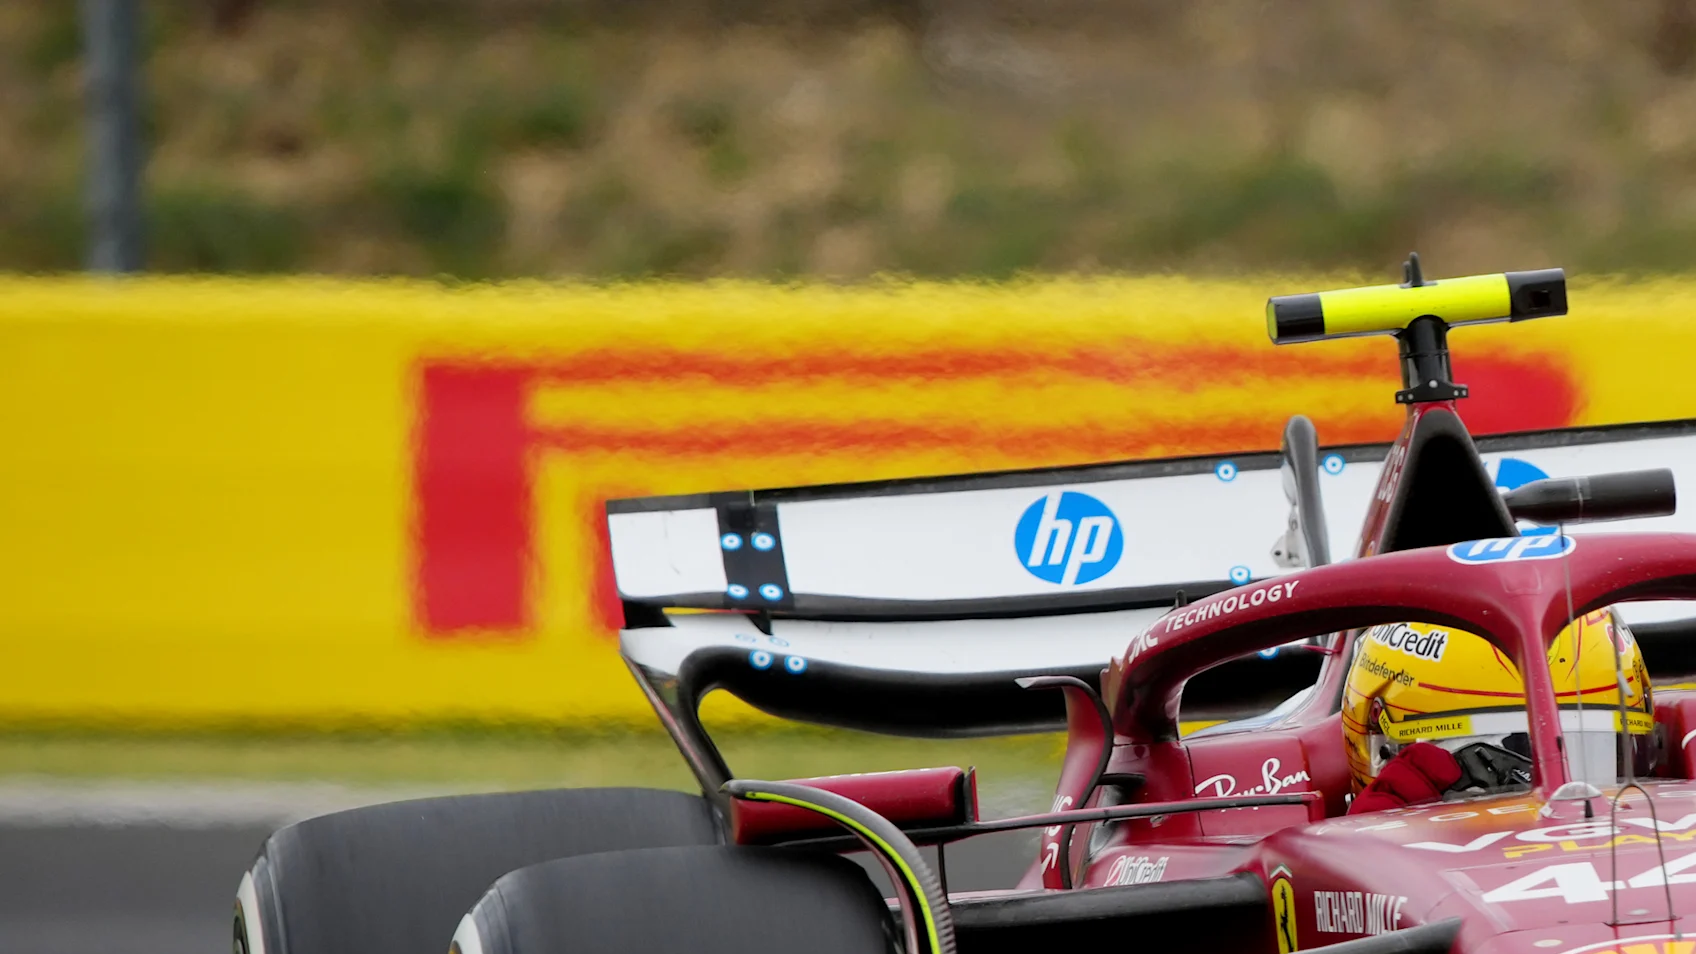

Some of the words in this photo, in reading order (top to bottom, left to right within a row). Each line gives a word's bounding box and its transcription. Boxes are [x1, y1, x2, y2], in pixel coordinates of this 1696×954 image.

[1026, 490, 1115, 586] hp
[1165, 580, 1299, 633] TECHNOLOGY
[1360, 652, 1414, 687] Bitdefender
[1399, 725, 1433, 737] RICHARD
[1435, 722, 1463, 734] MILLE
[1313, 890, 1364, 934] RICHARD
